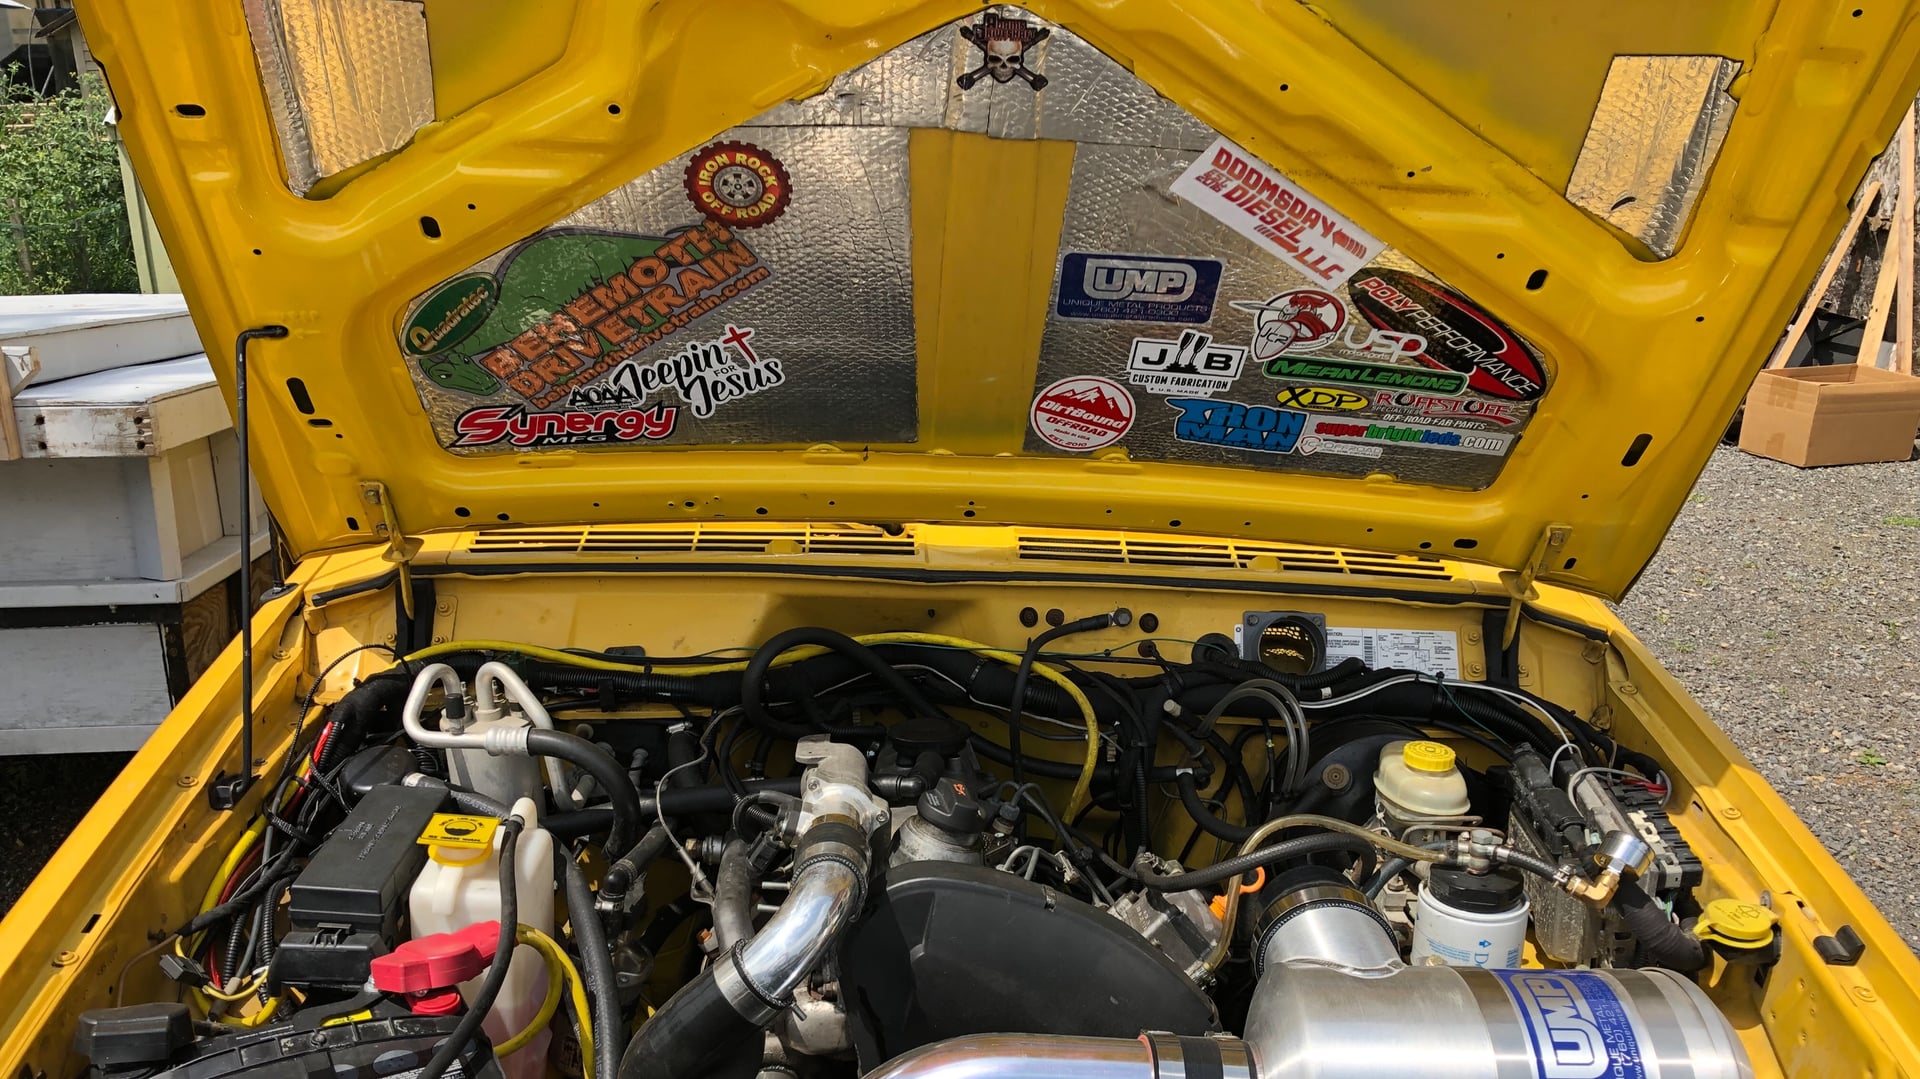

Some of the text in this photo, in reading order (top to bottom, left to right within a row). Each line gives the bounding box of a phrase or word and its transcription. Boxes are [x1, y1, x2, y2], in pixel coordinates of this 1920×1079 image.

[699, 153, 778, 188] IRON ROCK
[702, 191, 776, 218] OFF ROAD
[1211, 147, 1336, 238] DOOMSDAY
[1222, 184, 1309, 244] DIESEL
[1092, 266, 1189, 296] UMP
[1292, 246, 1346, 281] LLC
[480, 219, 735, 379] BEHEMOTH
[1063, 298, 1208, 312] UNIQUE METAL PRODUCTS
[410, 284, 489, 351] Quadratec
[505, 240, 759, 398] DRIVETRAIN
[1405, 309, 1540, 395] PERFORMANCE
[613, 343, 729, 401] Jeepin
[685, 359, 782, 416] Jesus
[713, 364, 738, 377] FOR
[1132, 373, 1229, 390] CUSTOM FABRICATION
[1040, 399, 1127, 429] DirtBound
[1279, 386, 1363, 408] XDP
[456, 405, 677, 446] Synergy
[1046, 416, 1108, 437] OFFROAD
[1166, 398, 1307, 435] IRON
[542, 434, 608, 445] MFG
[1176, 421, 1299, 448] MAN
[1314, 421, 1504, 451] superbrightleds.com
[1524, 977, 1597, 1067] UMP
